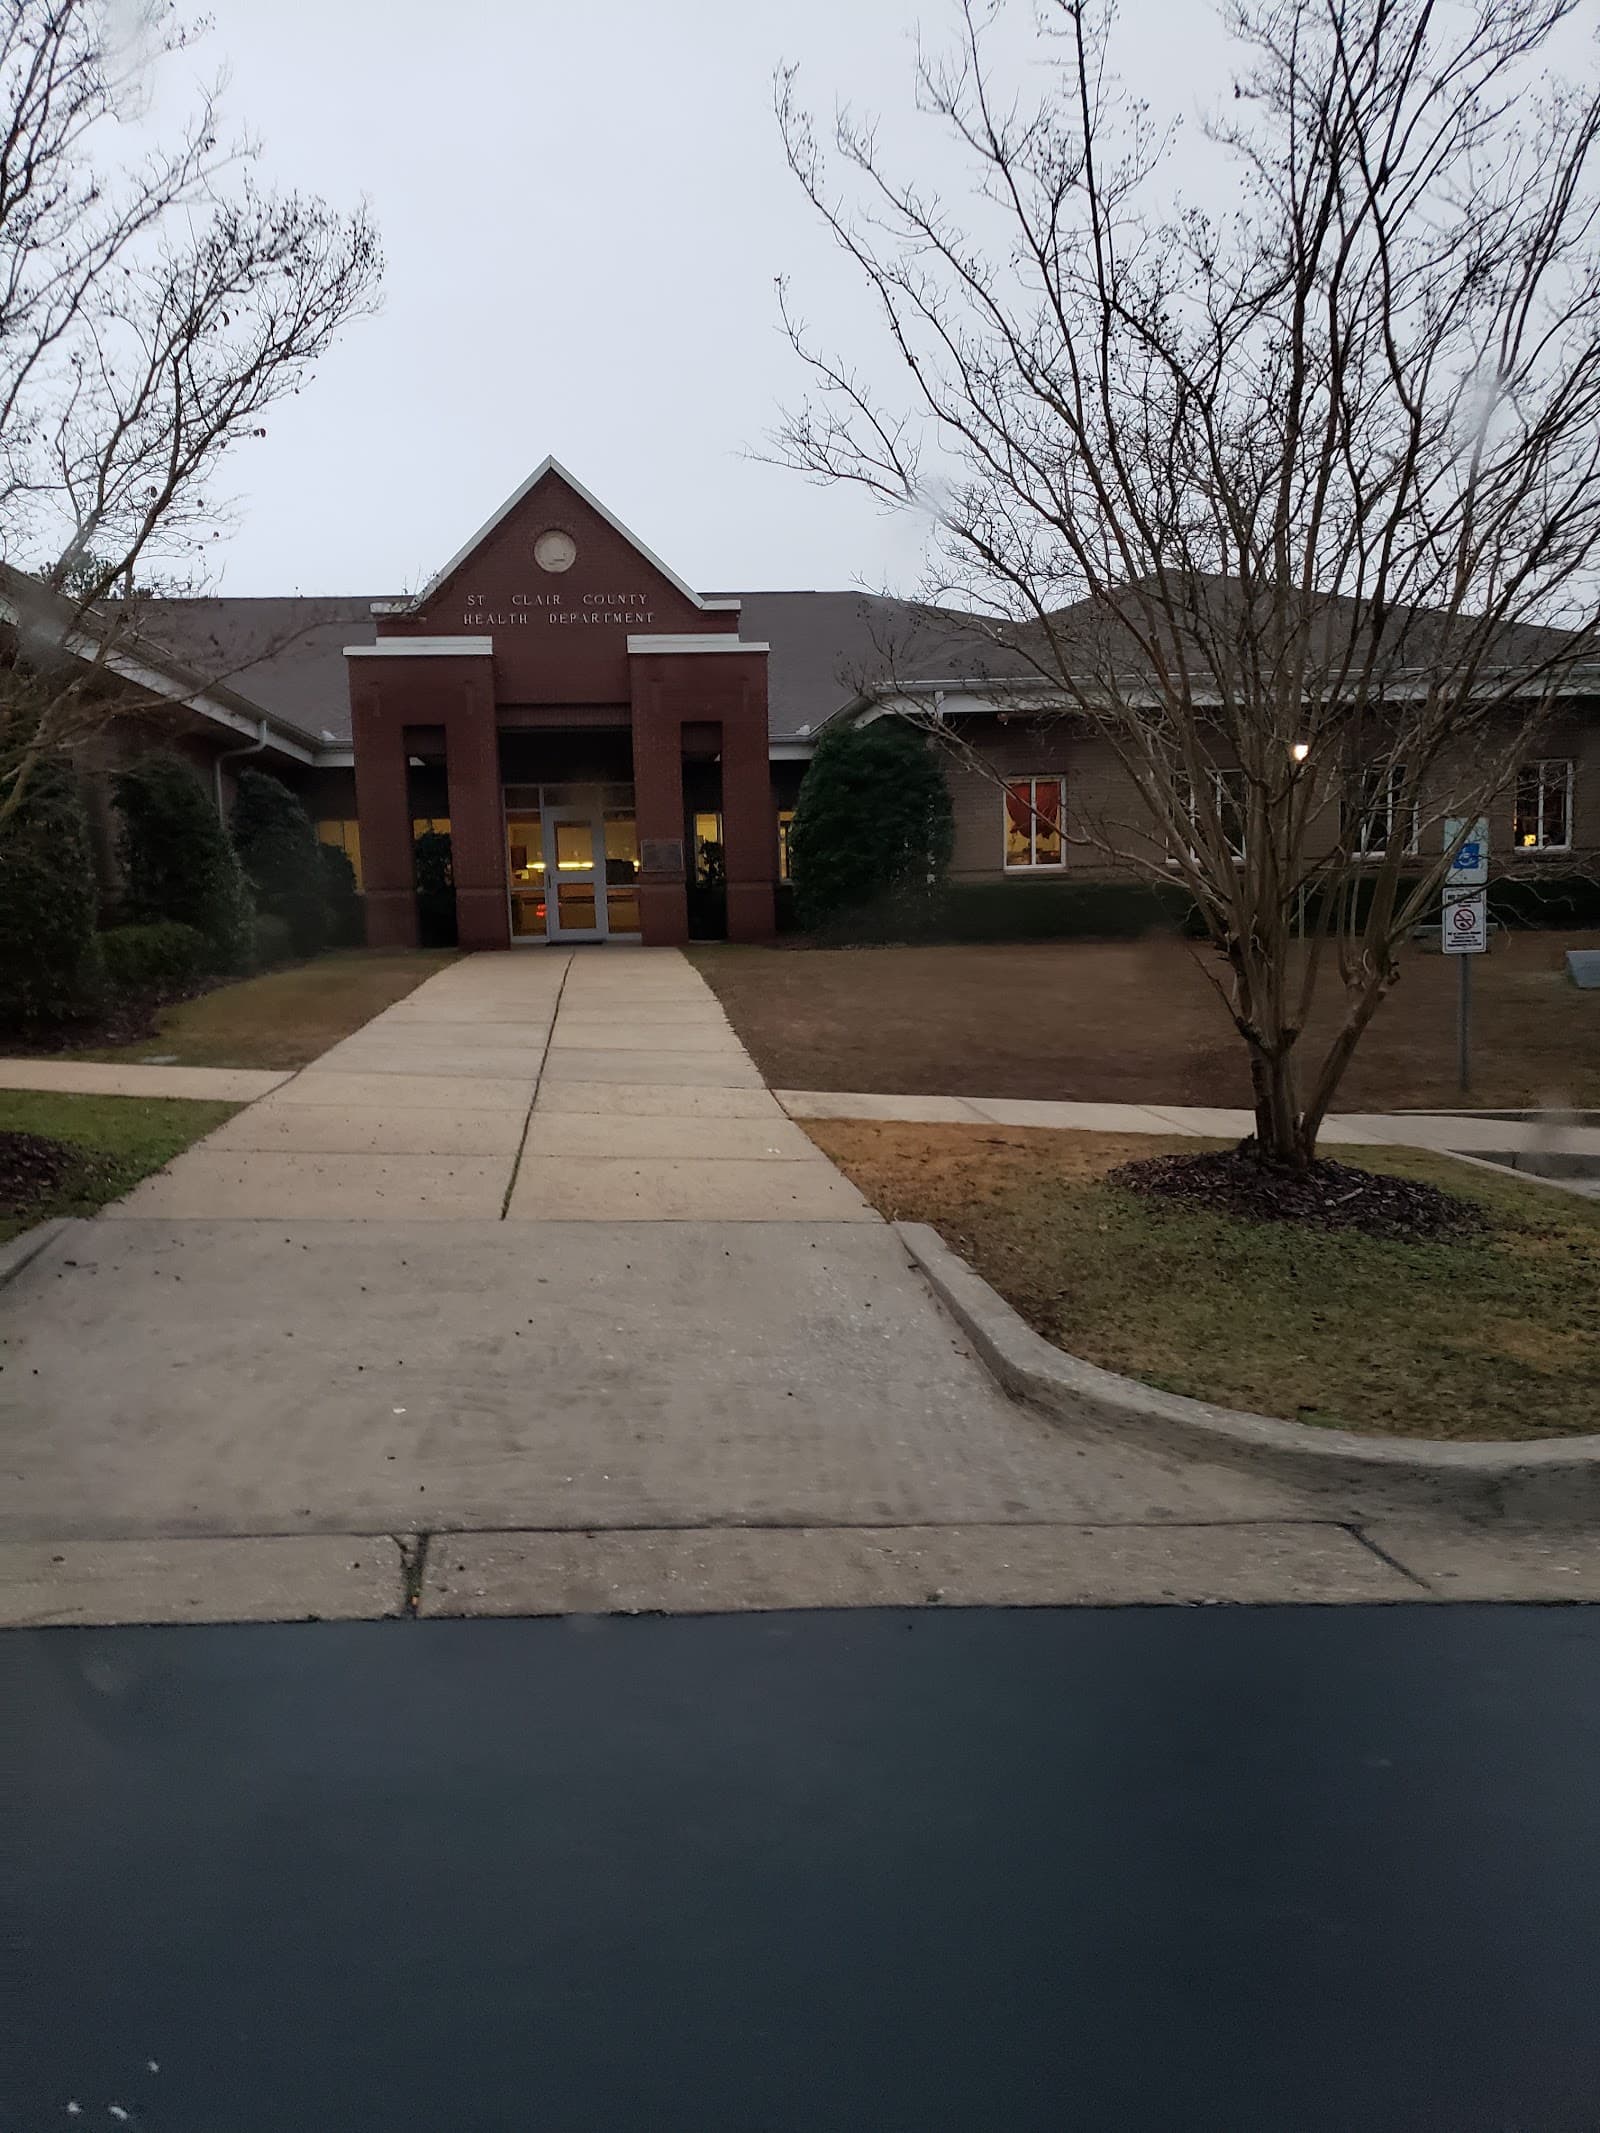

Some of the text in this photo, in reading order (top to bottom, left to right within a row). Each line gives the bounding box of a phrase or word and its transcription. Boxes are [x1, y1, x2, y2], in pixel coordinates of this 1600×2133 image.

[467, 594, 648, 606] ST CLAIR COUNTY
[463, 612, 655, 625] HEALTH DEPARTMENT
